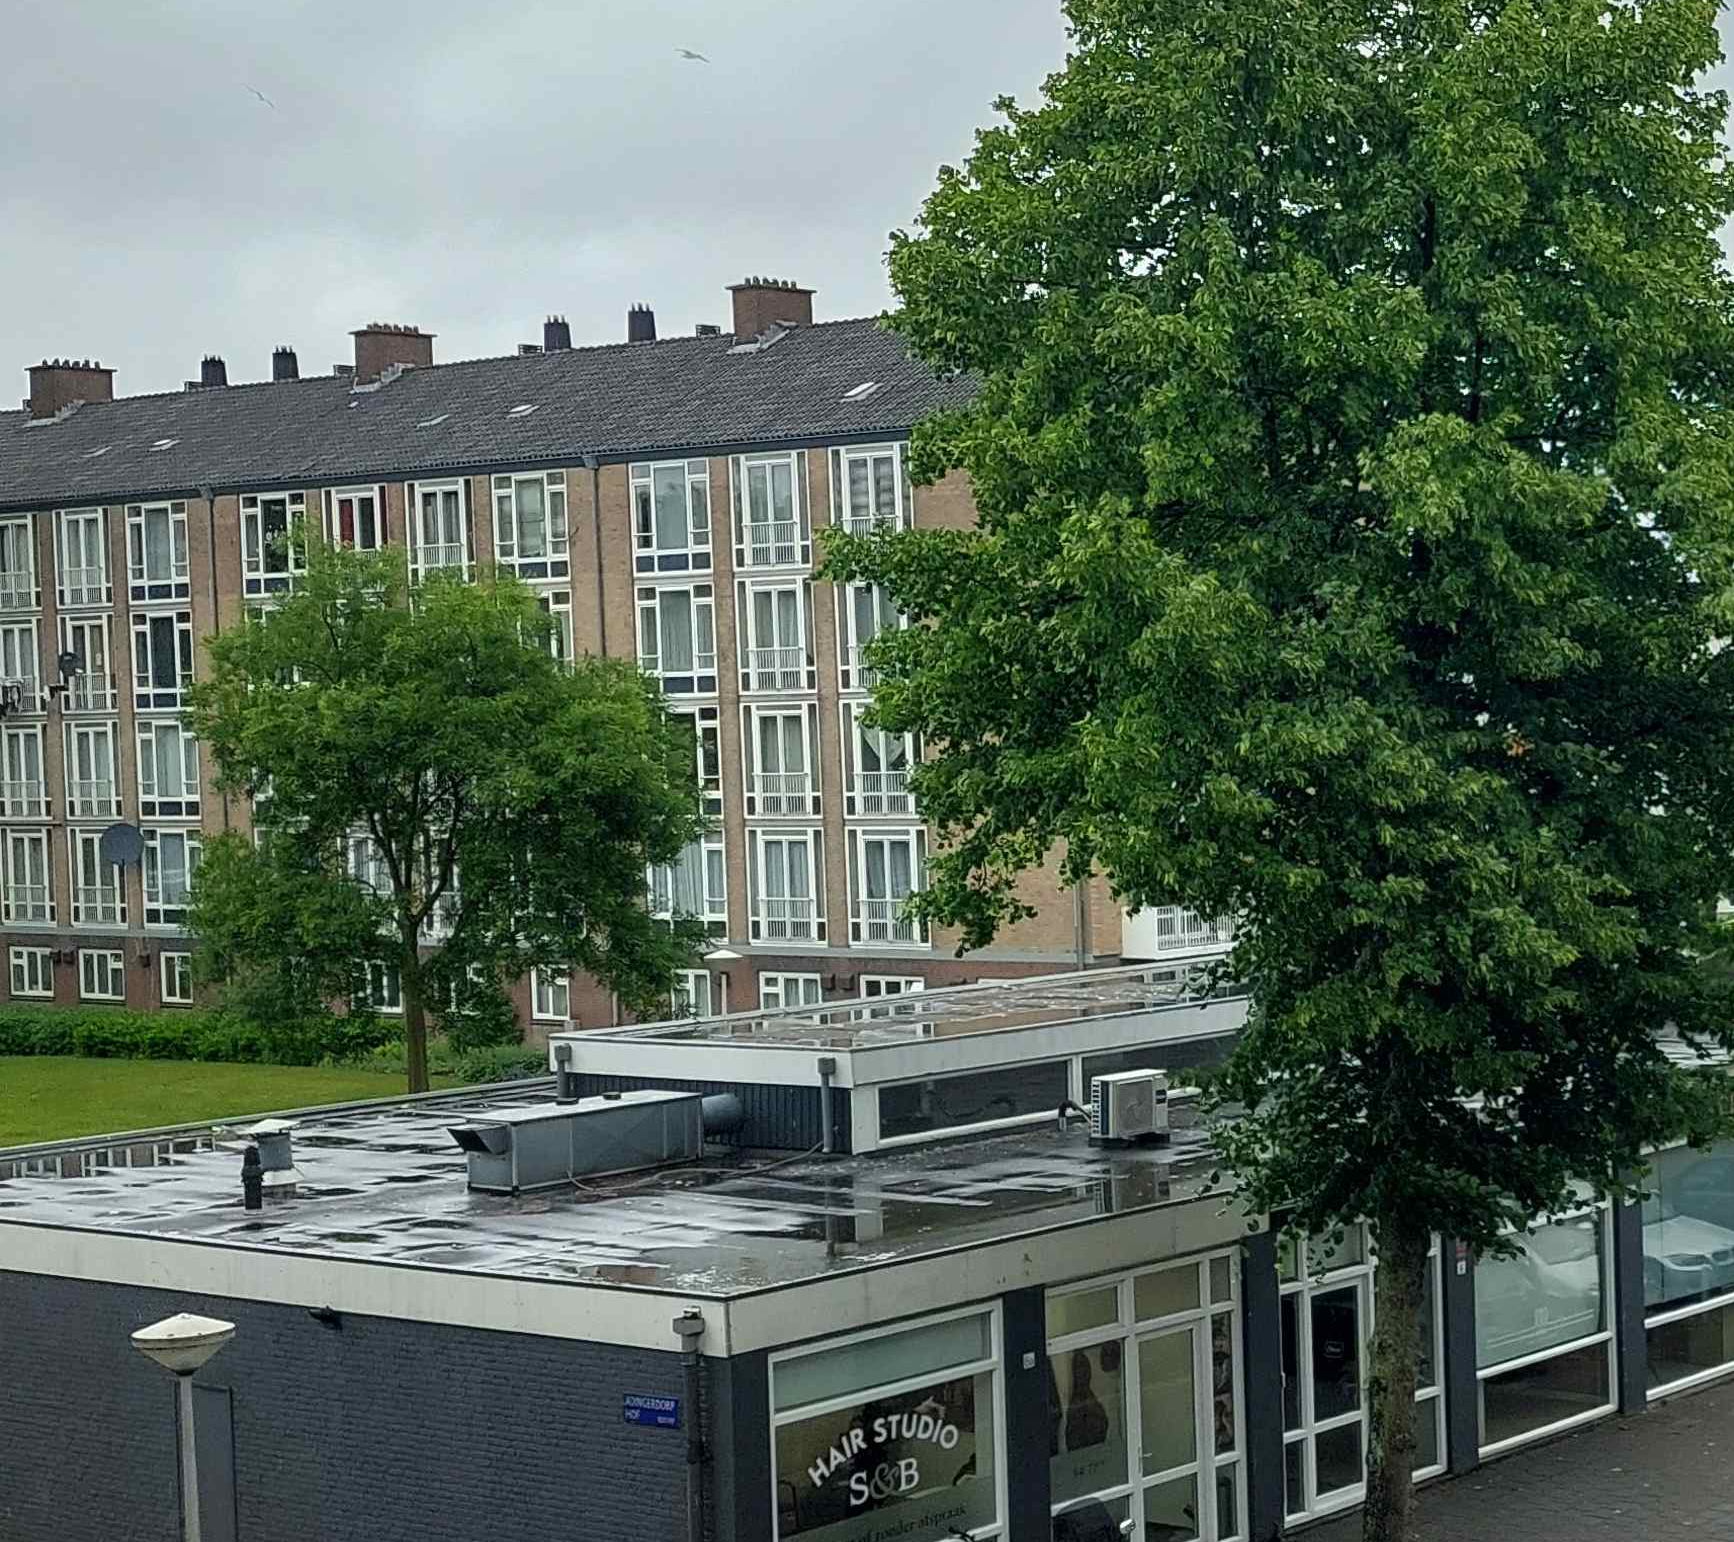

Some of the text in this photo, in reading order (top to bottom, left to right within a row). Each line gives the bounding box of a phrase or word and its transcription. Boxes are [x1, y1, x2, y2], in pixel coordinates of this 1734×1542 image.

[808, 1413, 959, 1488] HAIR STUDIO
[850, 1457, 919, 1506] S&B
